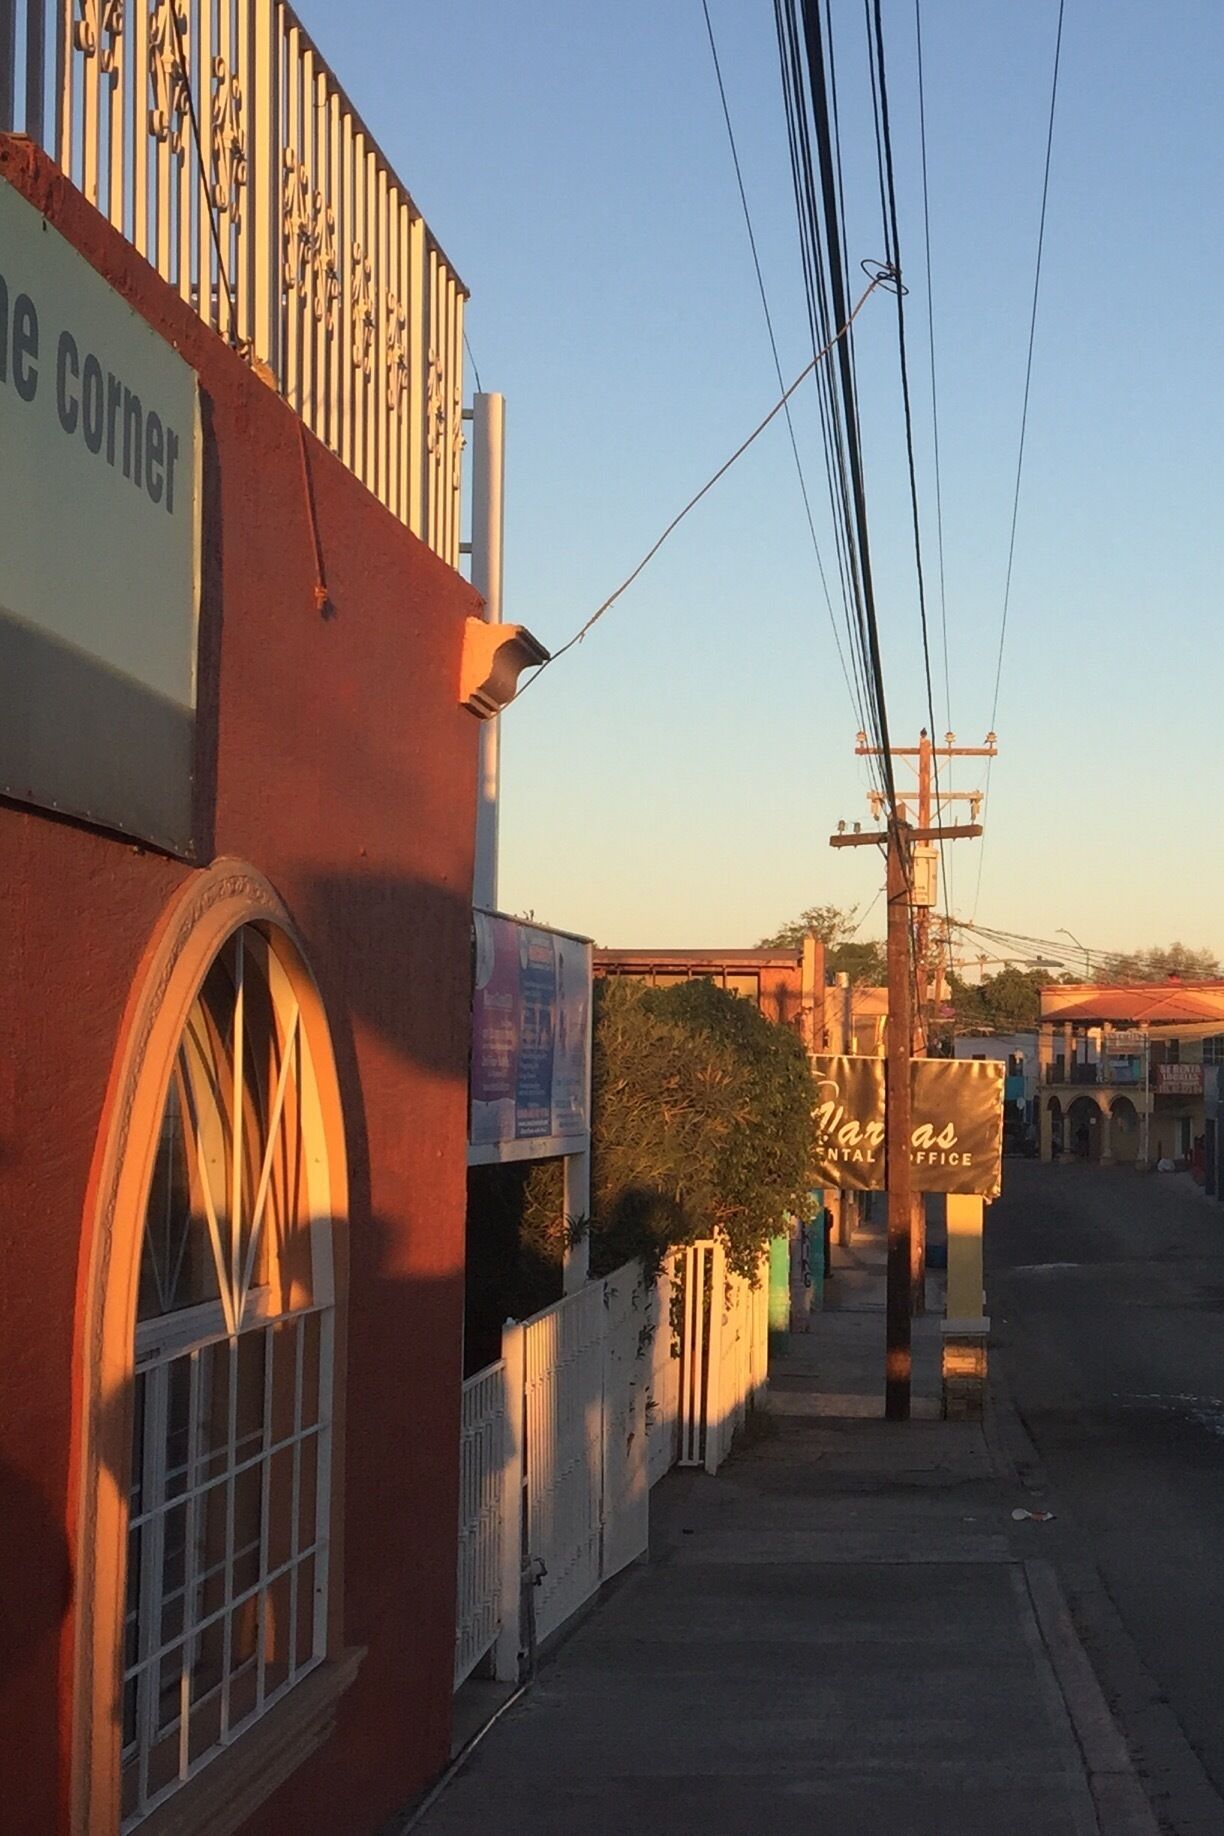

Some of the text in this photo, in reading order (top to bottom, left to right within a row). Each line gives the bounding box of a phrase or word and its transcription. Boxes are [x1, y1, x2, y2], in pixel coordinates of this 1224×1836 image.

[56, 330, 180, 515] corner
[811, 1101, 958, 1149] Varas
[909, 1151, 972, 1166] FFICE
